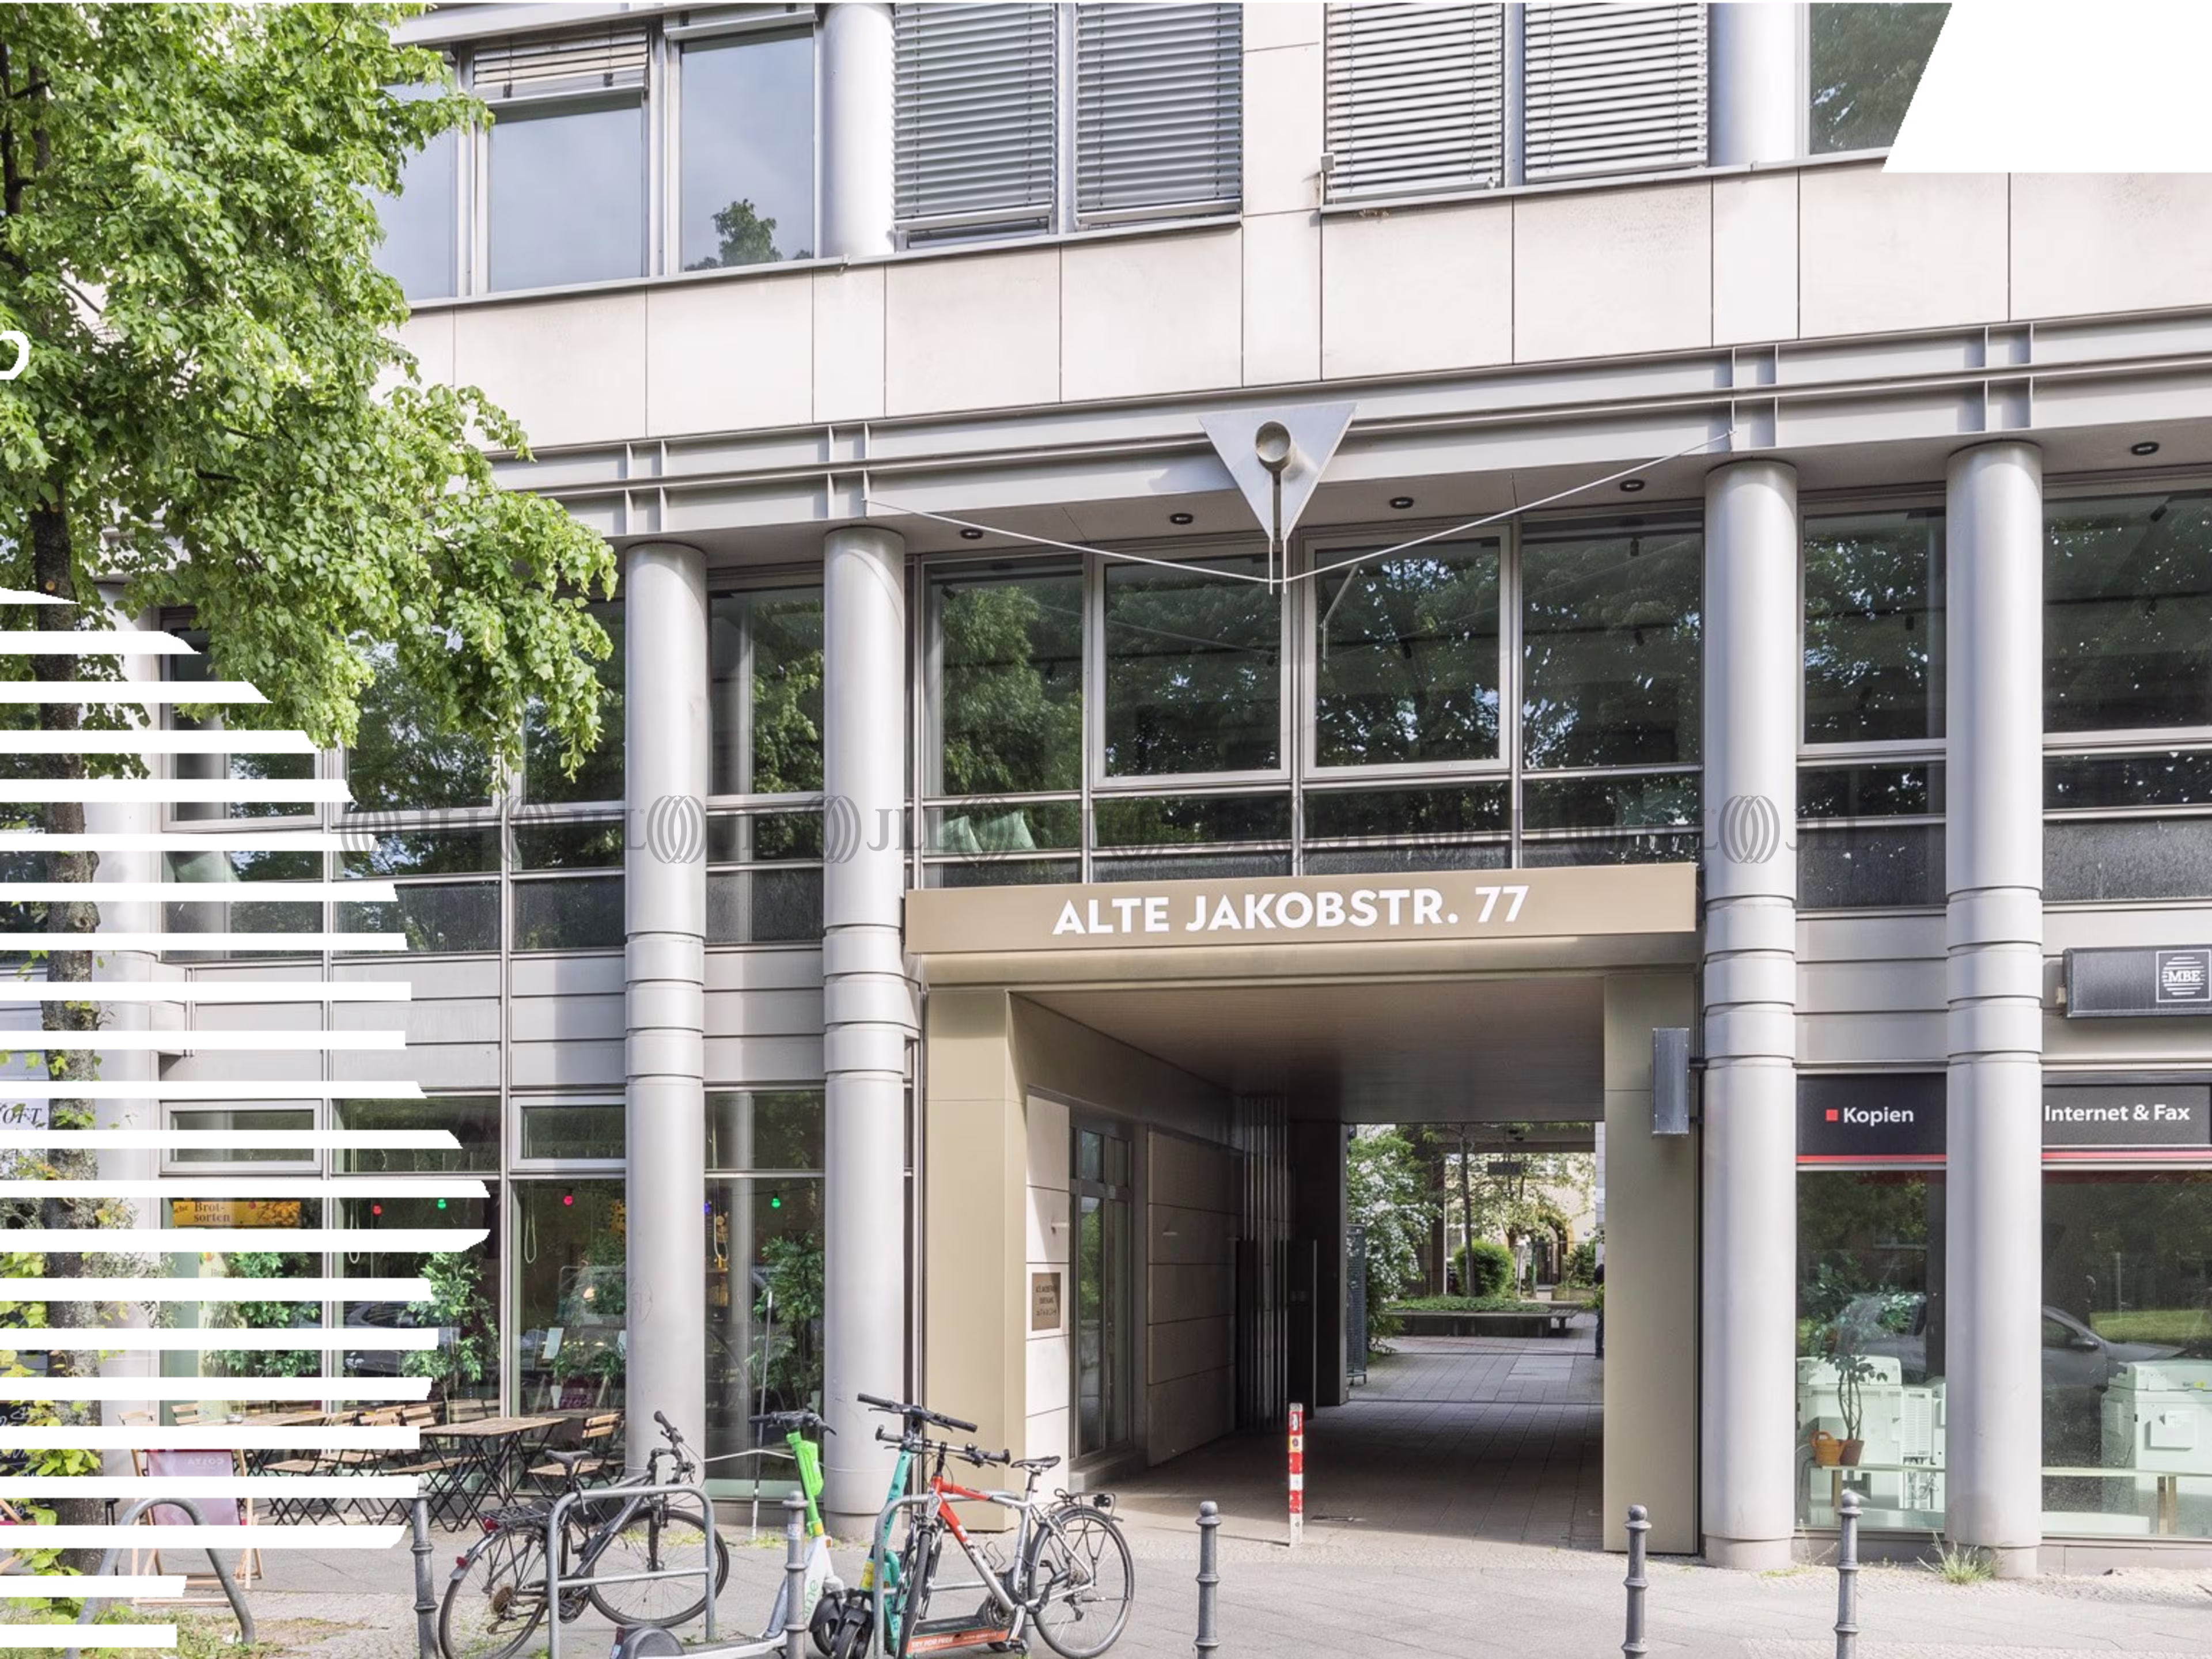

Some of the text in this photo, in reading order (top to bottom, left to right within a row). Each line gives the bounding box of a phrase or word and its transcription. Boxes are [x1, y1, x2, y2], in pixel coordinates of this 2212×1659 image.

[1052, 885, 1529, 935] ALTE JAKOBSTR. 77
[2168, 970, 2200, 982] MBE
[1844, 1107, 1914, 1127] Kopien
[2045, 1104, 2191, 1122] Internet & Fax
[194, 1202, 225, 1212] Brot-
[194, 1213, 230, 1222] sorten
